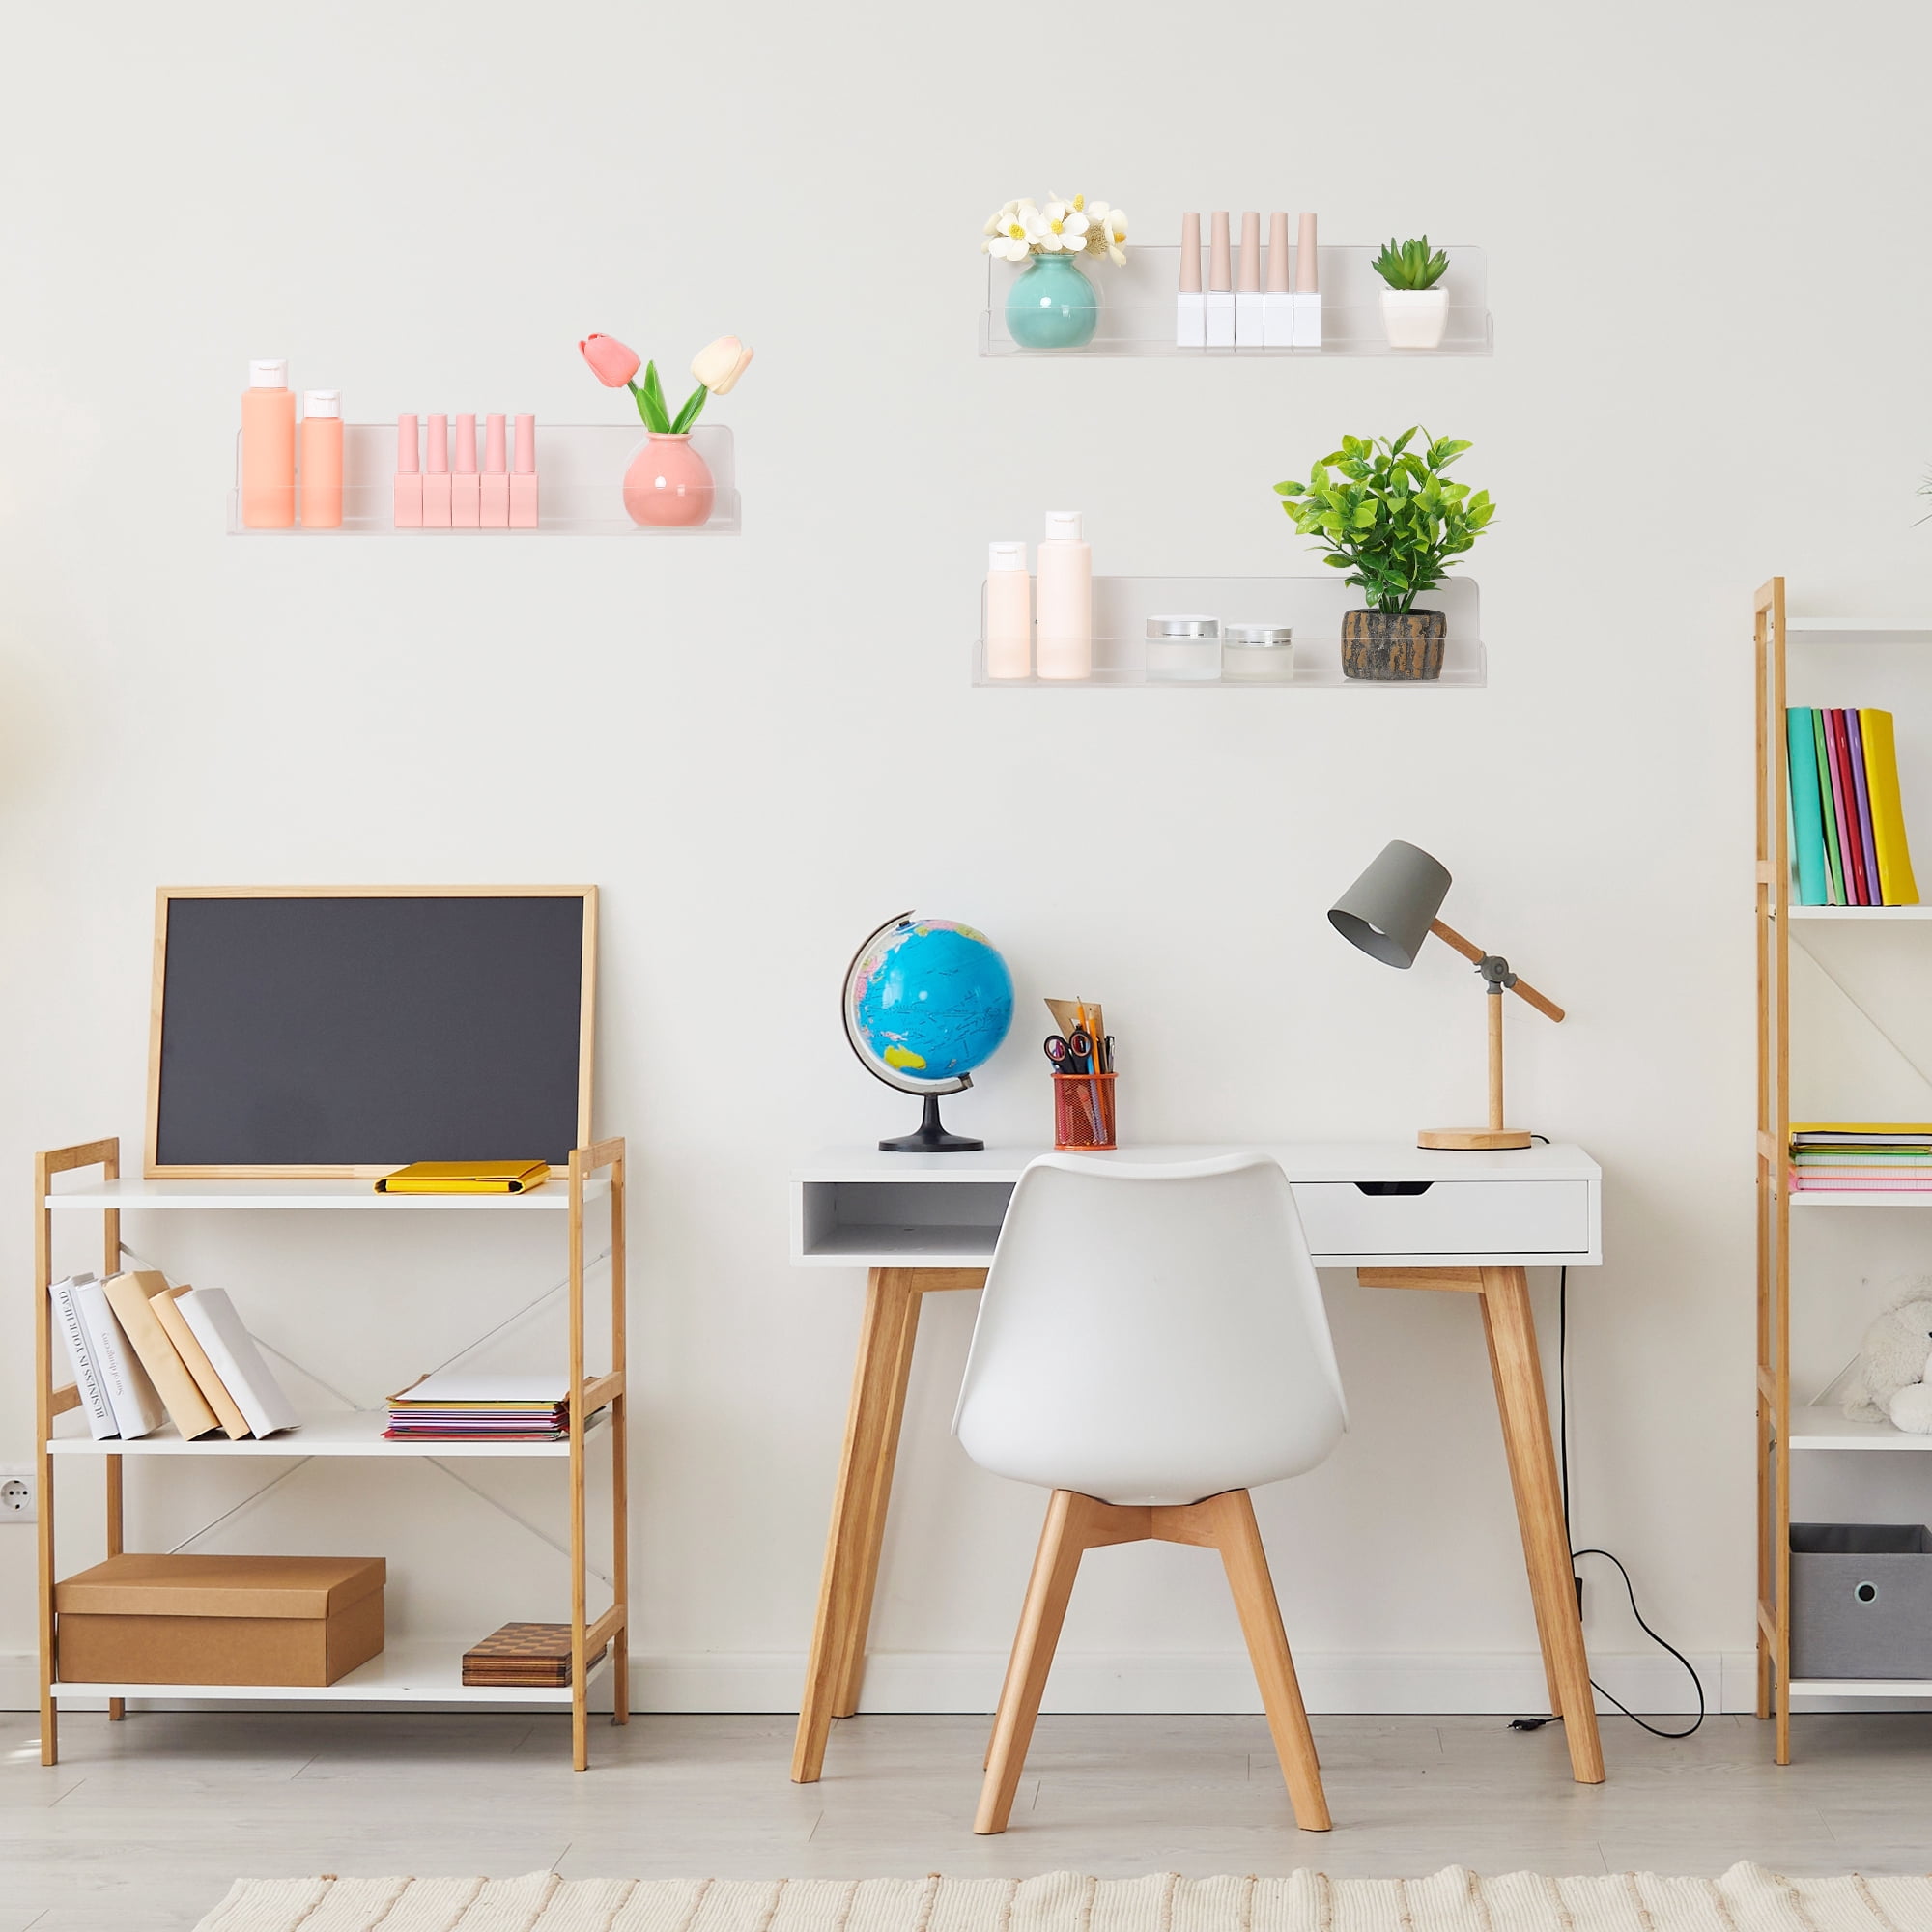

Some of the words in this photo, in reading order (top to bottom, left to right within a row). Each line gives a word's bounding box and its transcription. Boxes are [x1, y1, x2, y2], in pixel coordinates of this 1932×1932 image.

[59, 1291, 74, 1321] HEAD
[69, 1322, 85, 1353] YOUR
[78, 1354, 89, 1367] IN
[83, 1368, 104, 1419] BUSINESS
